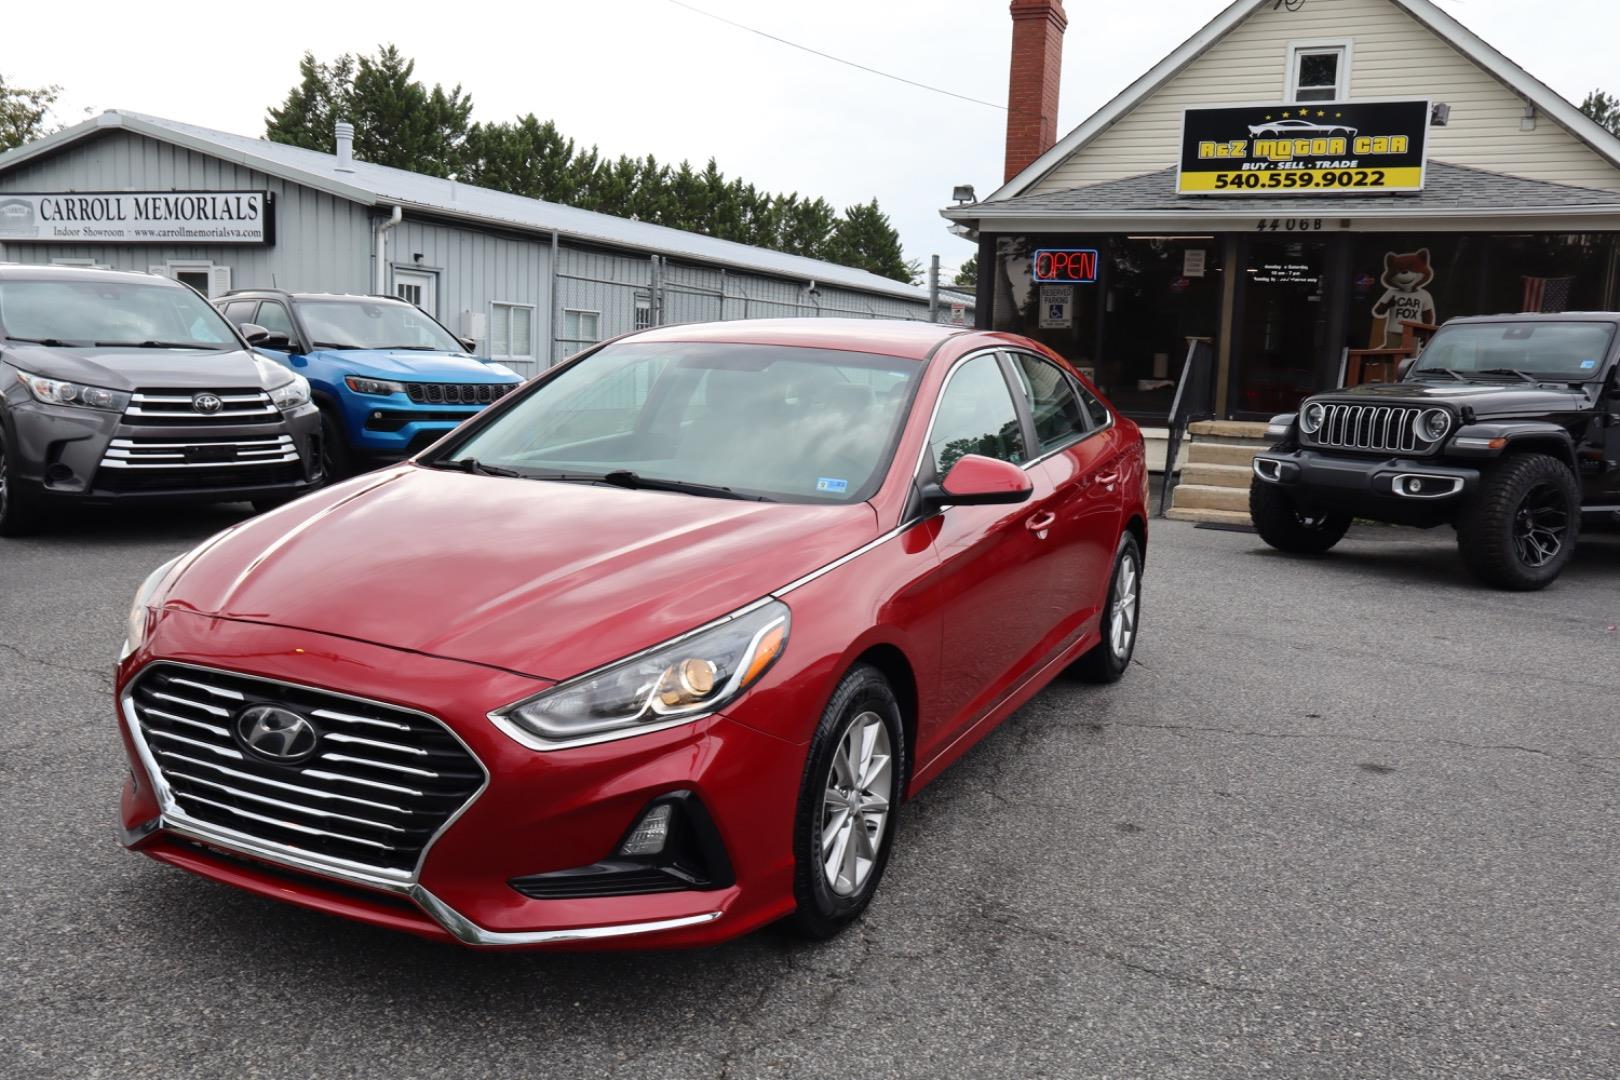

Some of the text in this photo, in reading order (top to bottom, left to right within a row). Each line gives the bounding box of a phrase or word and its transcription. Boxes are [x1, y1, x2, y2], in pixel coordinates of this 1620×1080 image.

[1241, 160, 1359, 171] BUY SELL TRADE
[1214, 171, 1385, 190] 540.559.9022
[40, 196, 259, 222] CARROLL MEMORIALS
[53, 226, 262, 238] Indoor Showroom www.carrollmemorialsva.com
[1037, 252, 1096, 279] OPEN
[1397, 297, 1421, 308] CAR
[1395, 308, 1418, 319] FOX
